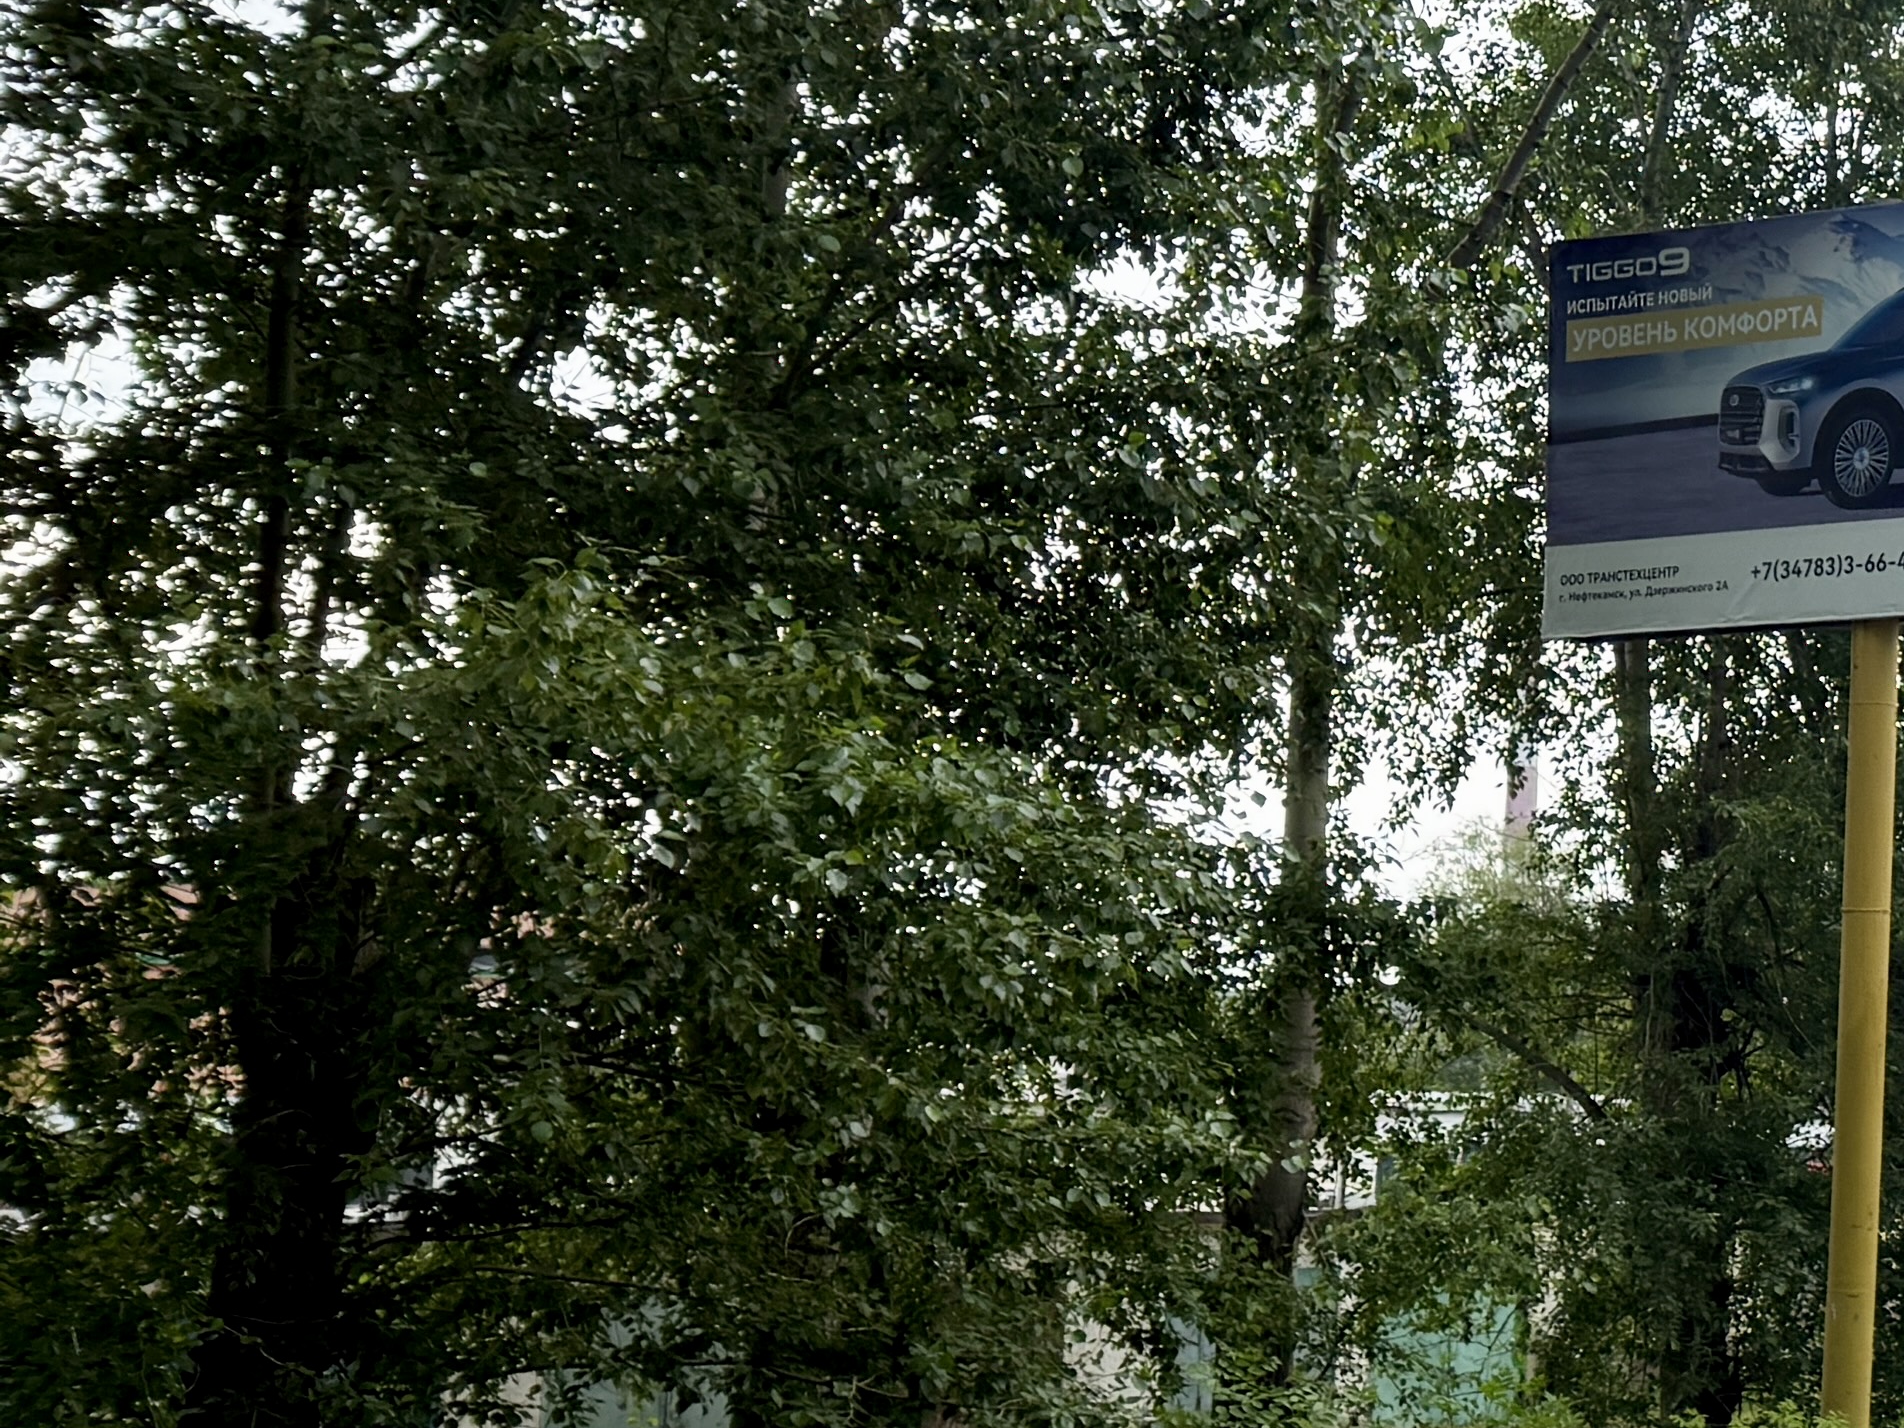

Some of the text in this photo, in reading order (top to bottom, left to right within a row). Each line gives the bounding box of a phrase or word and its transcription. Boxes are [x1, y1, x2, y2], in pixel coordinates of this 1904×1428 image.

[1567, 283, 1712, 314] ИСПЫТАЙТЕ НОВЫЙ
[1573, 304, 1818, 352] УРОВЕНЬ КОМФОРТА
[1560, 565, 1679, 586] ООО ТРАНСТЕХЦЕНТР
